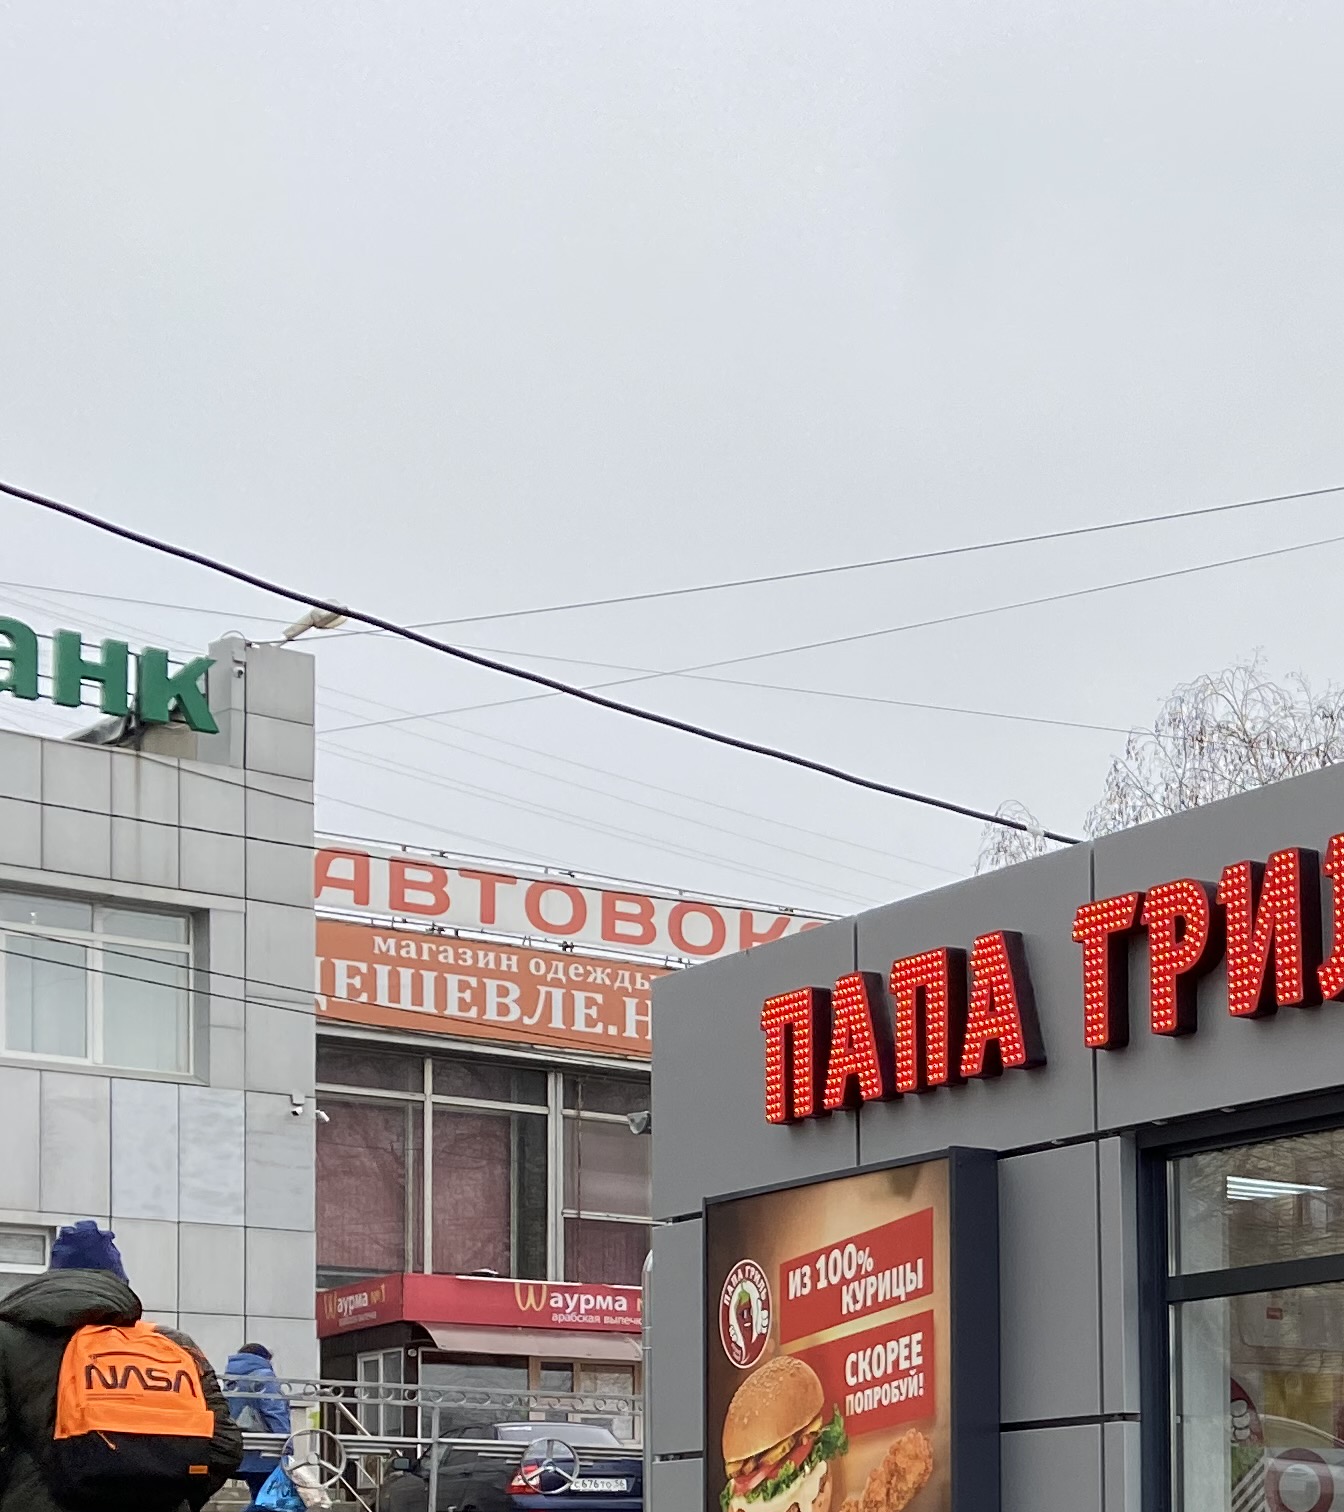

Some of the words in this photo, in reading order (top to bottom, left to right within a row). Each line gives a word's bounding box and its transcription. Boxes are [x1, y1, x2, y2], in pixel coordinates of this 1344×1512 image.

[314, 847, 828, 956] АВТОВОК
[372, 935, 519, 973] магазин
[760, 929, 1040, 1126] ПАПА
[789, 1265, 812, 1300] ИЗ
[816, 1243, 874, 1290] 100%
[841, 1258, 924, 1315] КУРИЦЫ
[85, 1364, 198, 1399] NASA
[845, 1332, 924, 1387] СКОРЕЕ
[845, 1369, 925, 1416] ПОПРОБУЙ!
